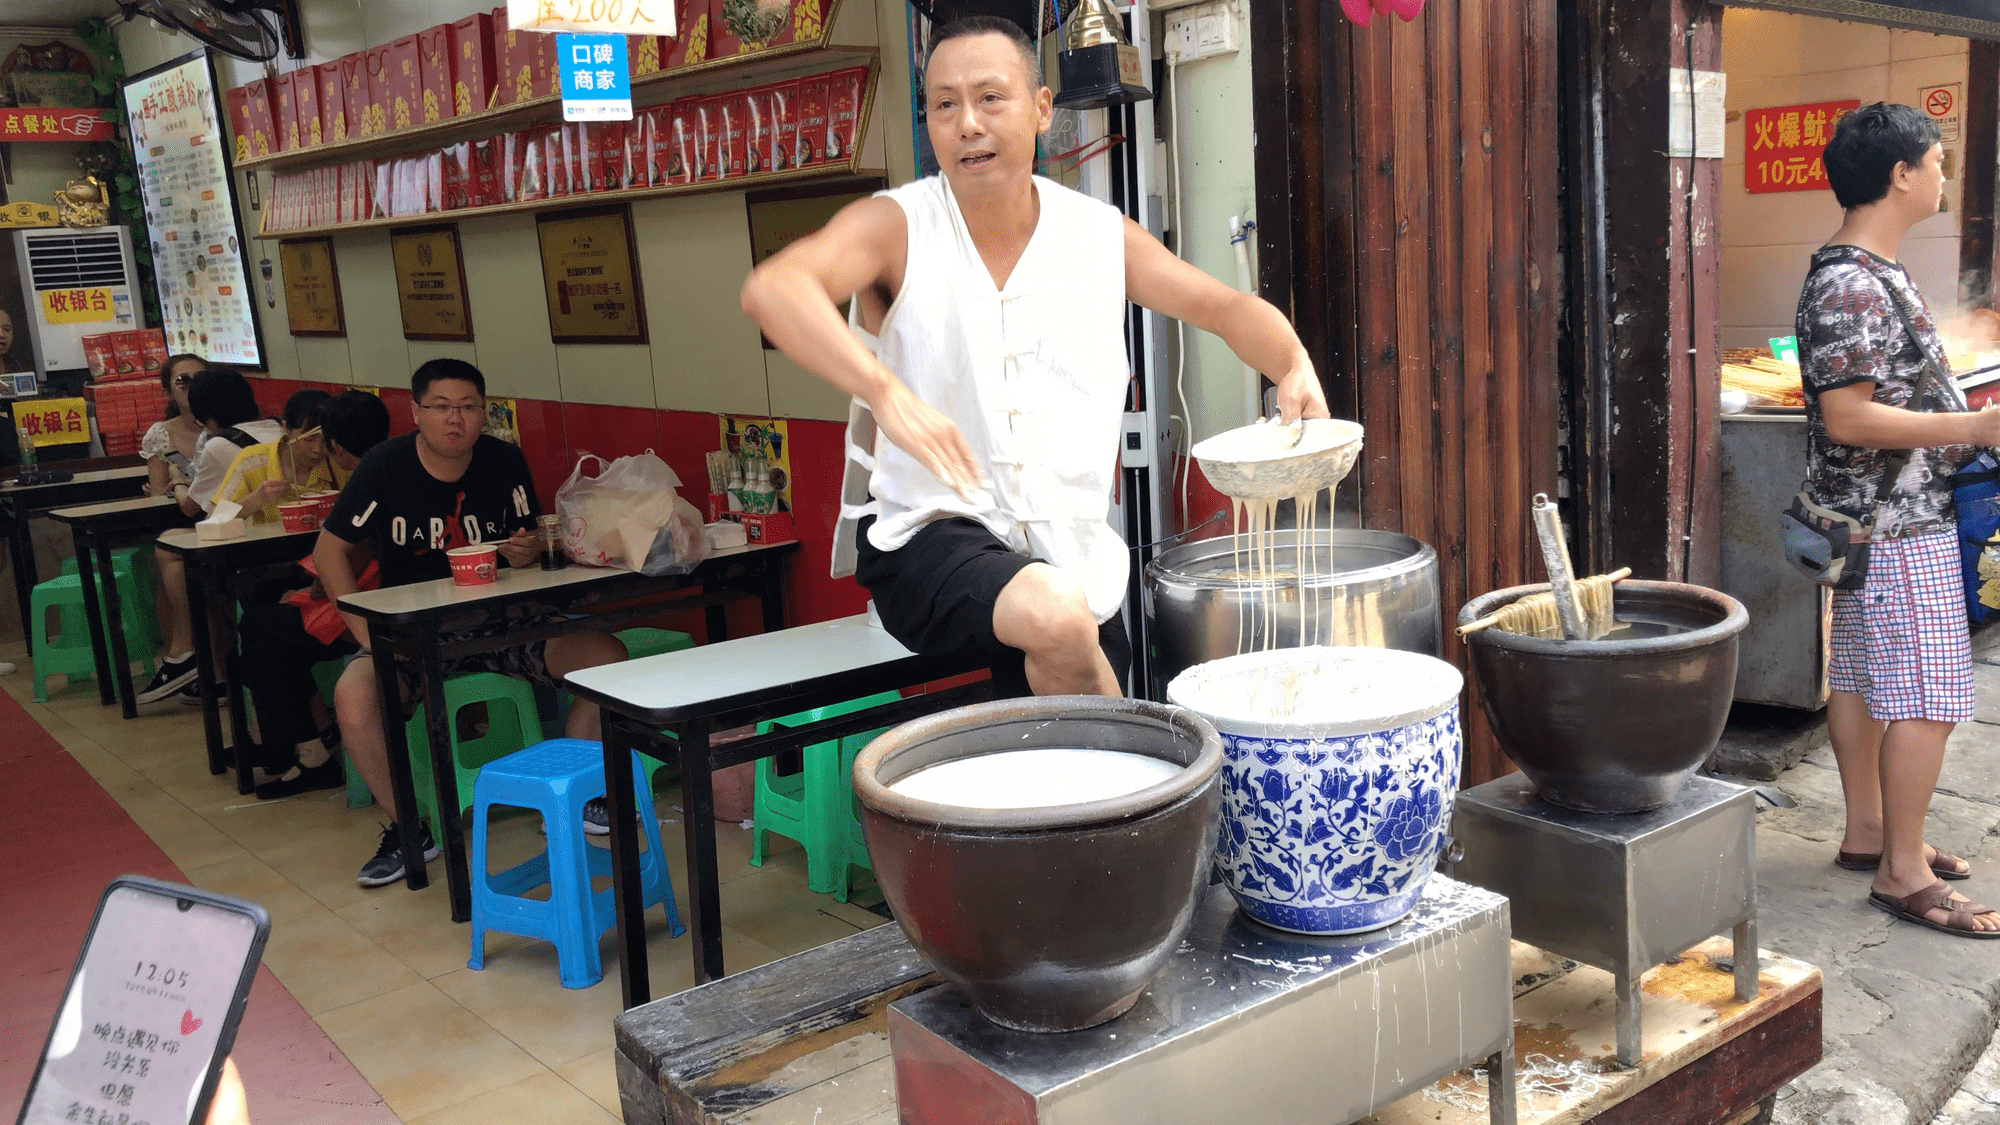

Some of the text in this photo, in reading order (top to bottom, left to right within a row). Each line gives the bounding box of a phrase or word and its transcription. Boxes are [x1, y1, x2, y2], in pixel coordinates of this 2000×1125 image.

[572, 44, 614, 65] 口碑
[573, 69, 616, 91] 商家
[5, 114, 59, 134] 点餐处
[1753, 108, 1849, 151] 火爆鱿
[1758, 157, 1828, 185] 10元4
[49, 289, 106, 312] 收银台
[22, 409, 82, 436] 收银台
[134, 961, 189, 988] 12:05
[93, 1022, 180, 1055] 晚点遇见你
[103, 1050, 151, 1078] 没关系
[100, 1083, 135, 1106] 但愿
